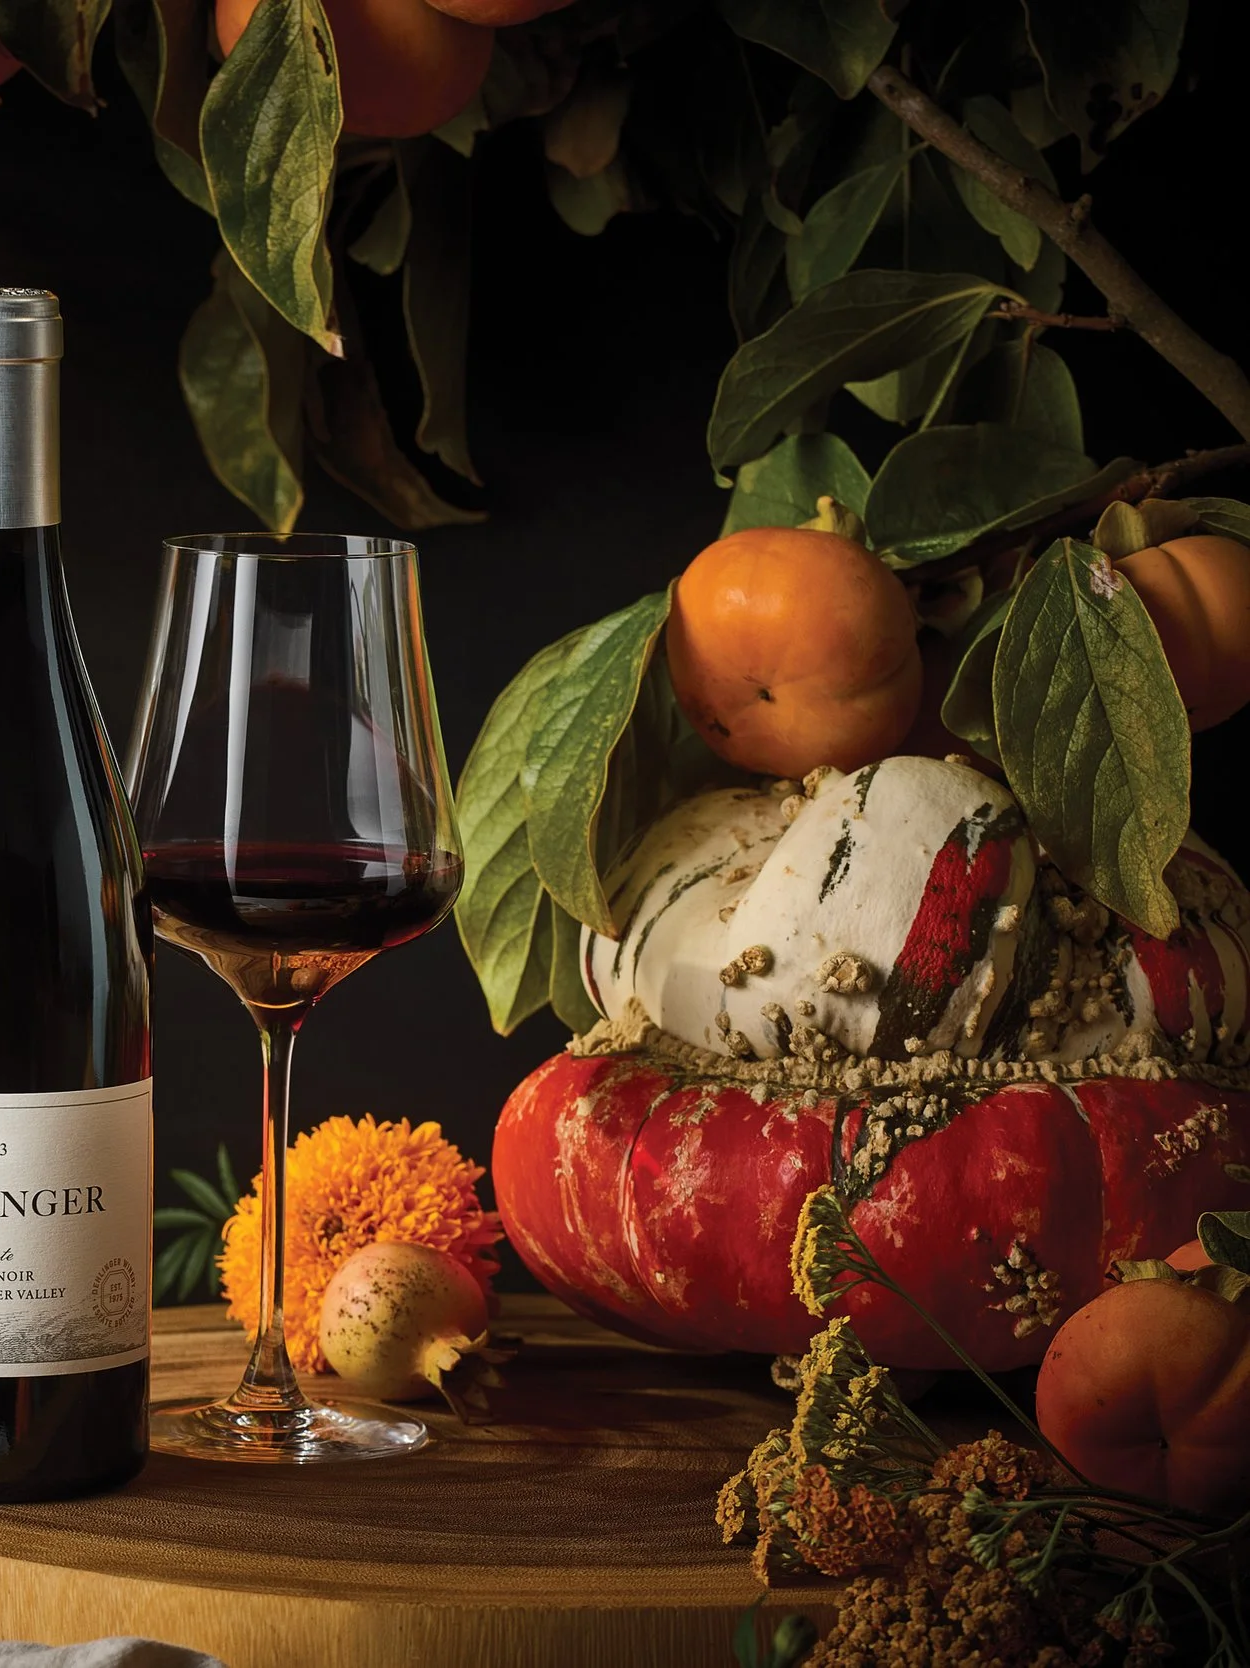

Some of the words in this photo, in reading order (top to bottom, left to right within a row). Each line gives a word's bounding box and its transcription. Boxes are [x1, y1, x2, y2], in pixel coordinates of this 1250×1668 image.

[92, 1258, 121, 1295] DEHLINGER
[110, 1283, 123, 1292] EST.
[17, 1287, 67, 1300] VALLEY
[109, 1294, 124, 1303] 1975
